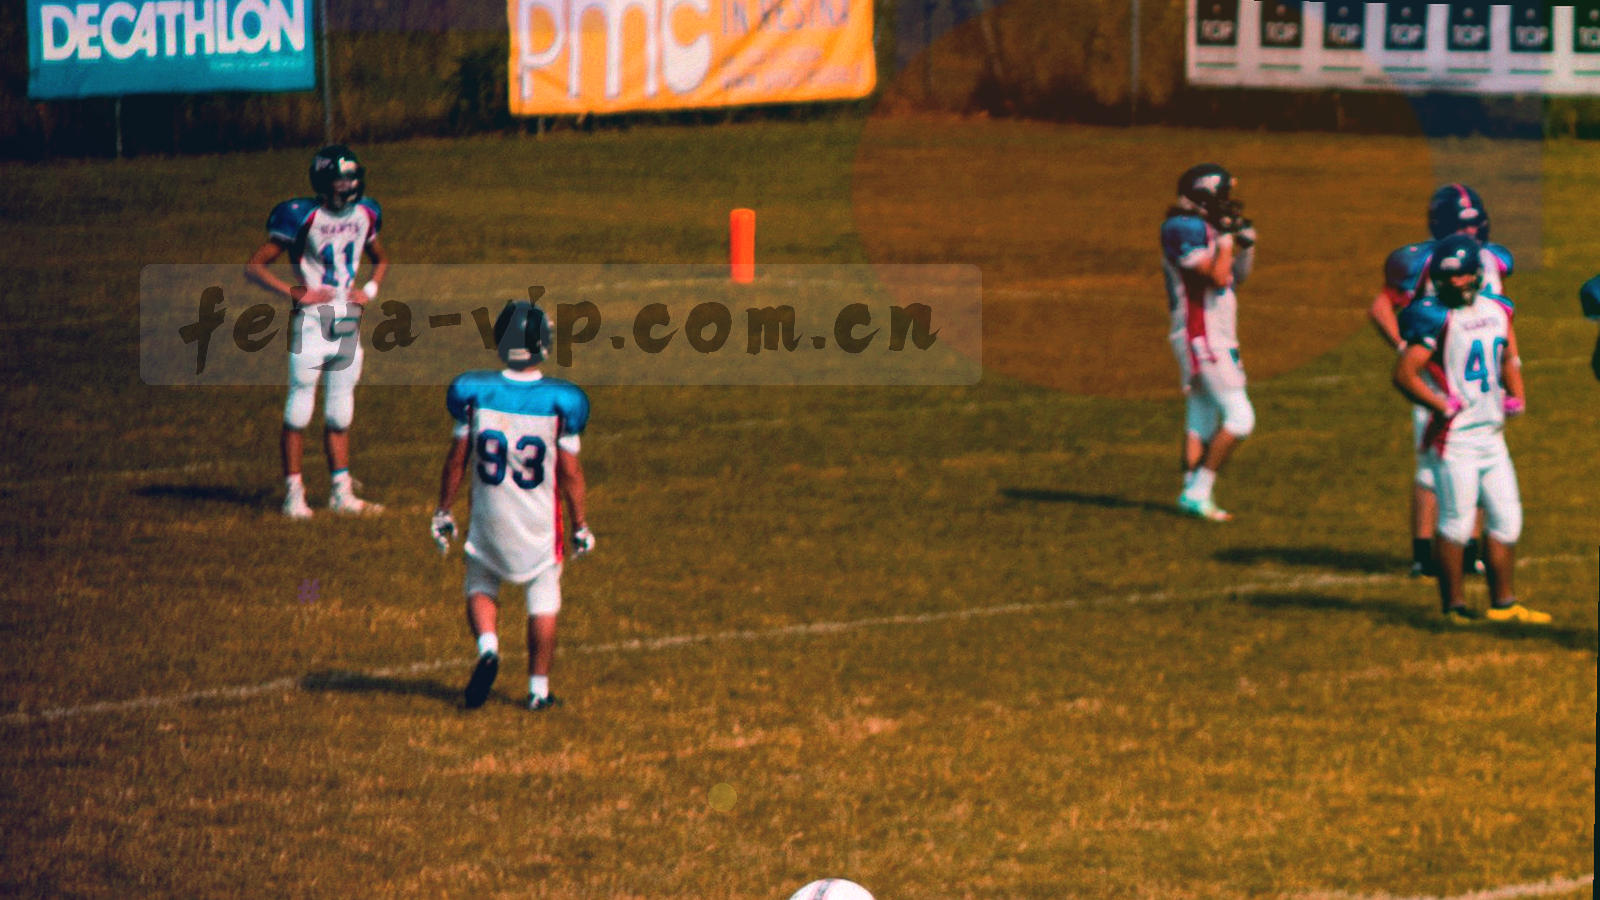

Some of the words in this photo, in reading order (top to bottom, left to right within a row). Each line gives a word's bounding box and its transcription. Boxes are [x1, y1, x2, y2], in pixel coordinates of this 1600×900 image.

[40, 0, 306, 61] DECATHLON
[1578, 27, 1600, 47] TO
[319, 241, 356, 288] 11
[476, 429, 547, 489] 93
